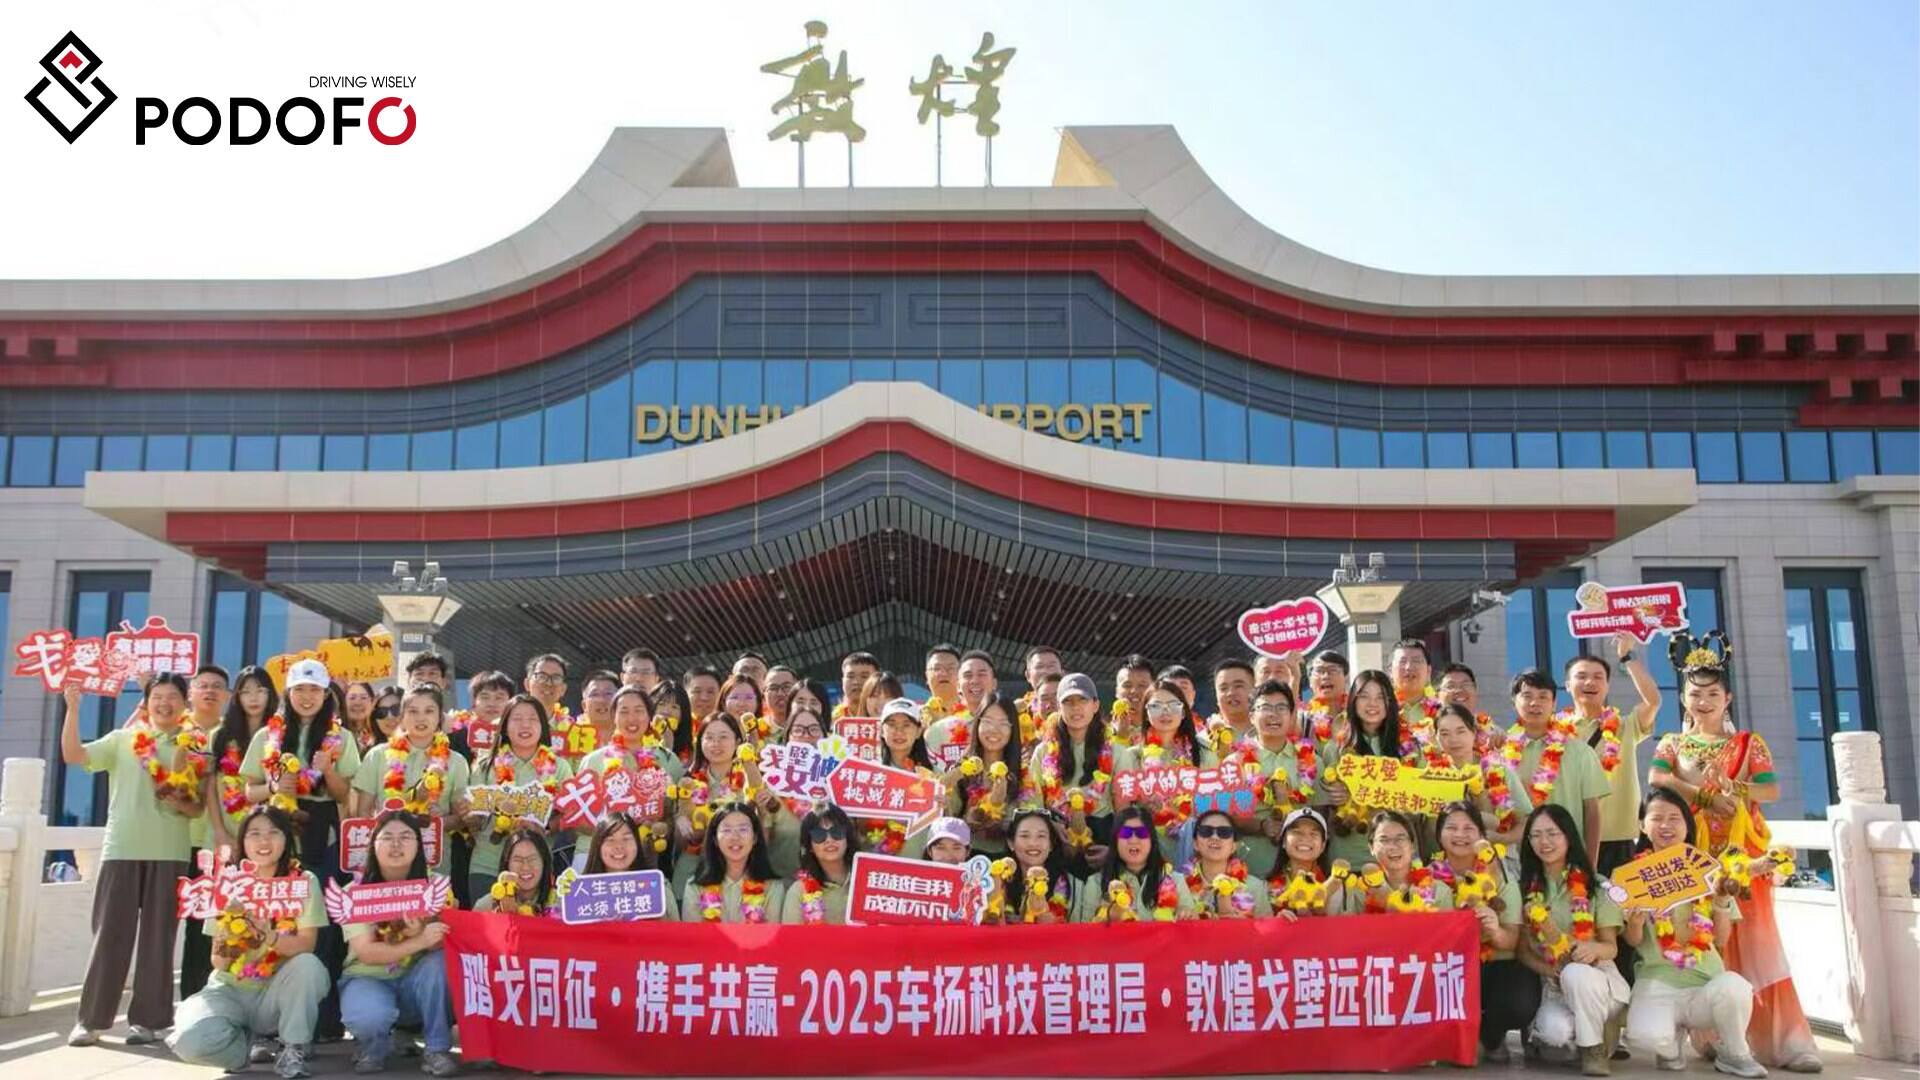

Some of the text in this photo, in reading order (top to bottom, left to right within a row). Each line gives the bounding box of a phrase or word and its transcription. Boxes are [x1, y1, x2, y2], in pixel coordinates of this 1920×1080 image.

[635, 404, 806, 443] DUNH
[838, 767, 887, 786] 我要去
[1340, 756, 1399, 782] 去戈壁
[1625, 856, 1688, 883] 一起出发
[573, 879, 637, 897] 人生苦短
[867, 871, 953, 897] 超越自我
[1633, 873, 1698, 900] 一起到达
[863, 894, 949, 920] 成就不凡
